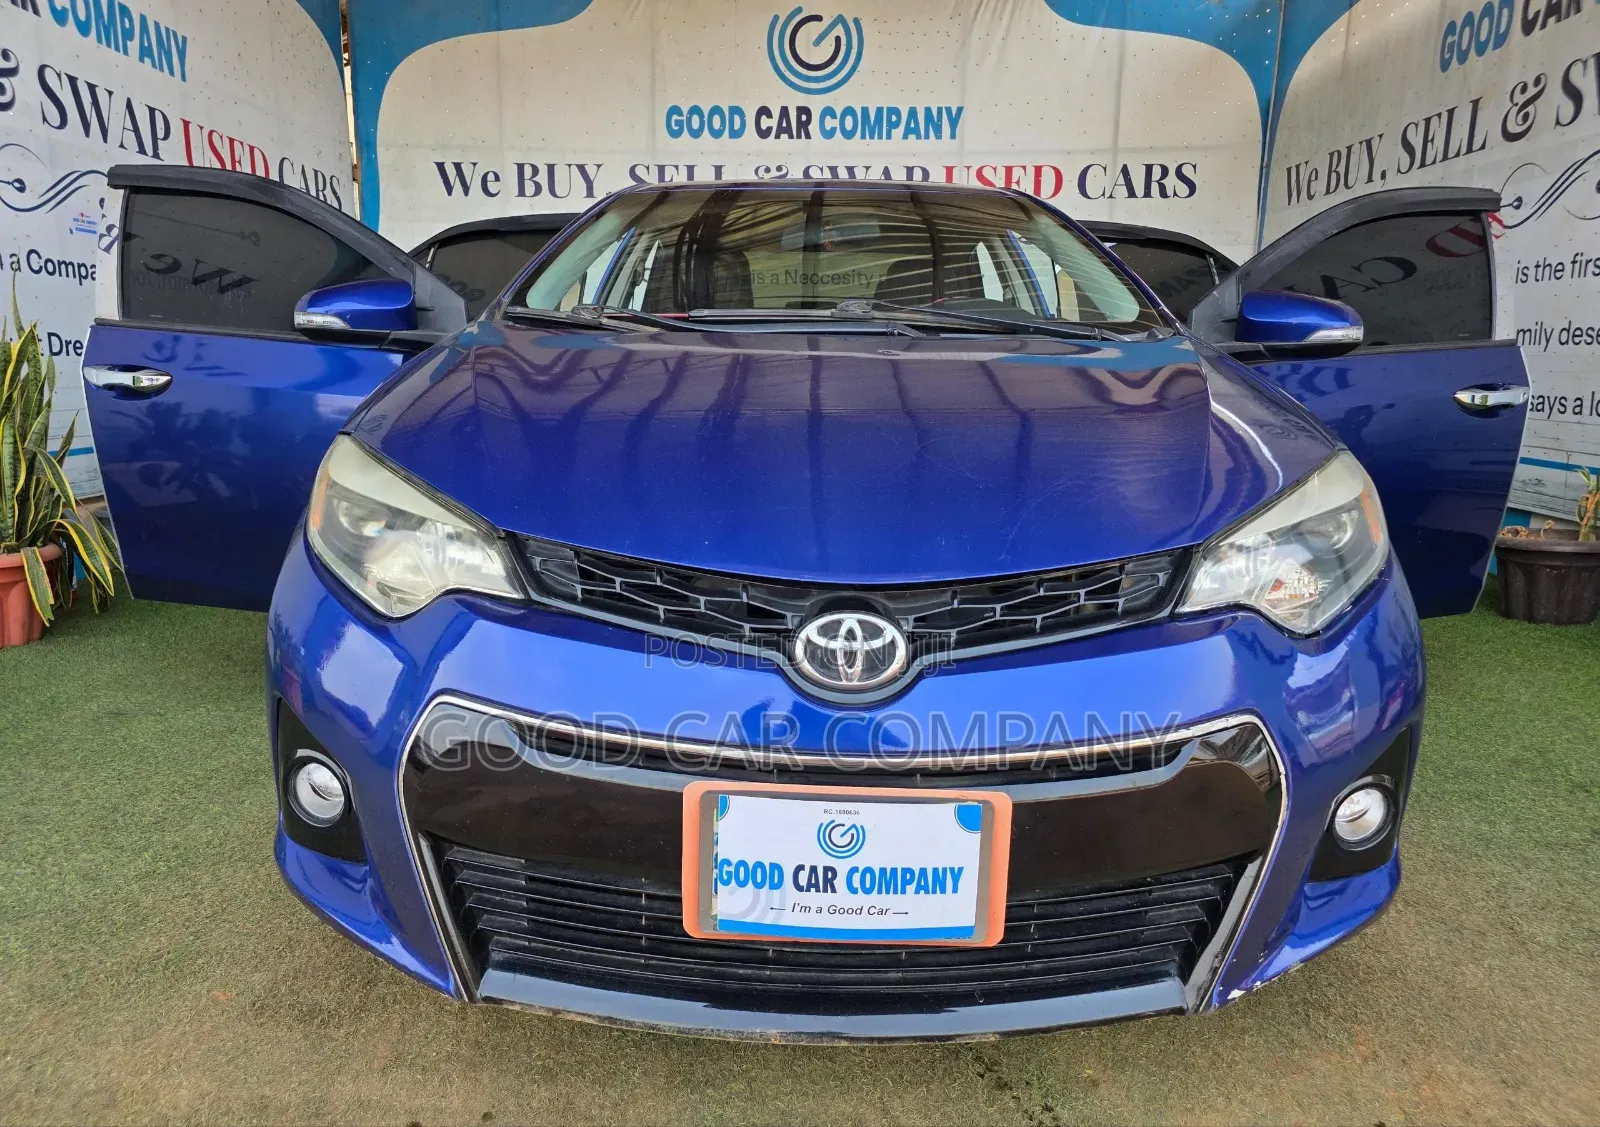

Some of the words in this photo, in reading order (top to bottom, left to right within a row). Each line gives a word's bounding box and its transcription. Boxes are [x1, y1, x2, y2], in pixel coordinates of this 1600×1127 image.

[1439, 0, 1515, 73] GOOD
[37, 63, 171, 161] SWAP
[665, 104, 747, 140] GOOD
[754, 105, 812, 140] CAR
[818, 105, 964, 140] COMPANY
[1285, 160, 1318, 207] We
[1323, 133, 1388, 196] BUY,
[1397, 96, 1489, 176] SELL
[1501, 72, 1547, 143] &
[1554, 51, 1600, 130] S
[433, 160, 502, 198] We
[1077, 162, 1197, 200] CARS
[1515, 260, 1530, 284] is
[1534, 257, 1565, 283] the
[1572, 396, 1583, 420] a
[718, 858, 784, 890] GOOD
[792, 863, 838, 894] CAR
[846, 866, 964, 896] COMPANY
[791, 902, 812, 914] I'm
[815, 906, 824, 915] a
[827, 904, 863, 916] Good
[867, 905, 890, 916] Car
